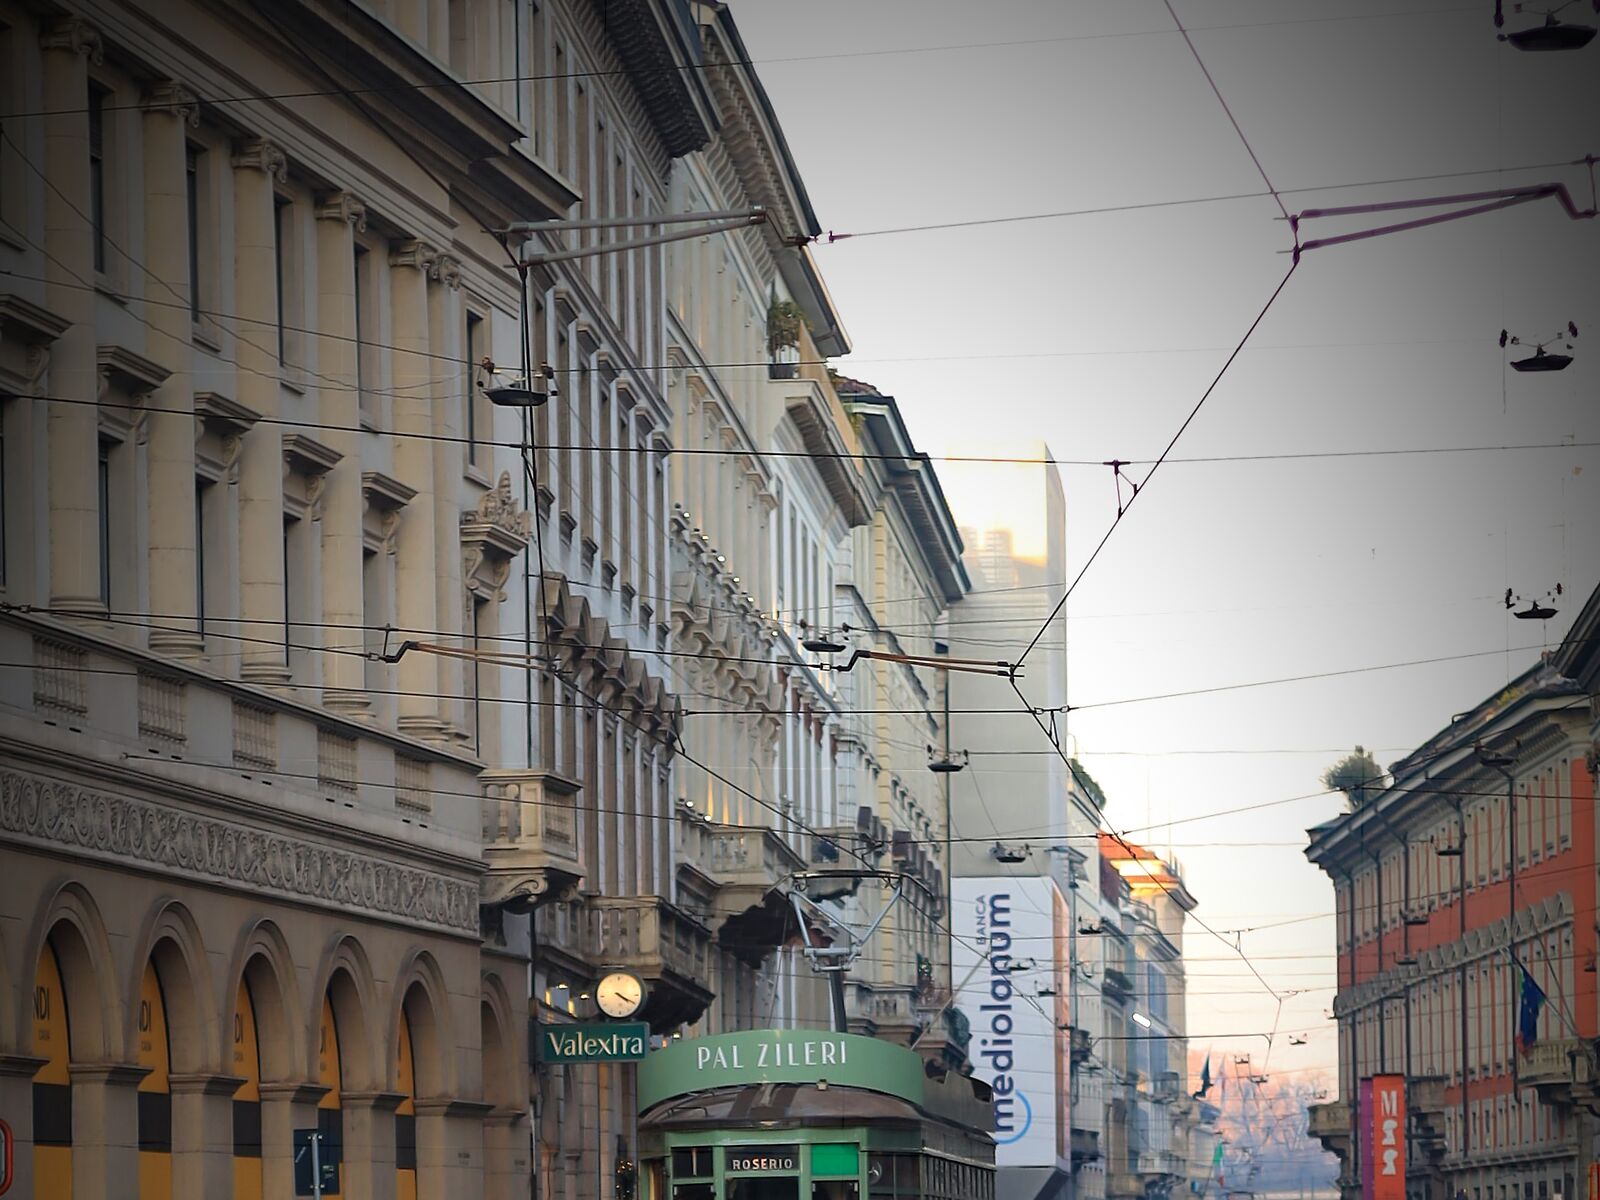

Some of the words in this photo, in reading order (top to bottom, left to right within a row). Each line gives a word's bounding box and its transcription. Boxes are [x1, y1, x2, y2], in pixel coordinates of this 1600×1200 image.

[976, 894, 987, 945] BANCA
[980, 893, 1014, 1133] mediolanum
[547, 1031, 644, 1056] Valextra
[697, 1045, 744, 1070] PAL
[757, 1040, 846, 1067] ZILERI
[731, 1158, 793, 1170] ROSERIO
